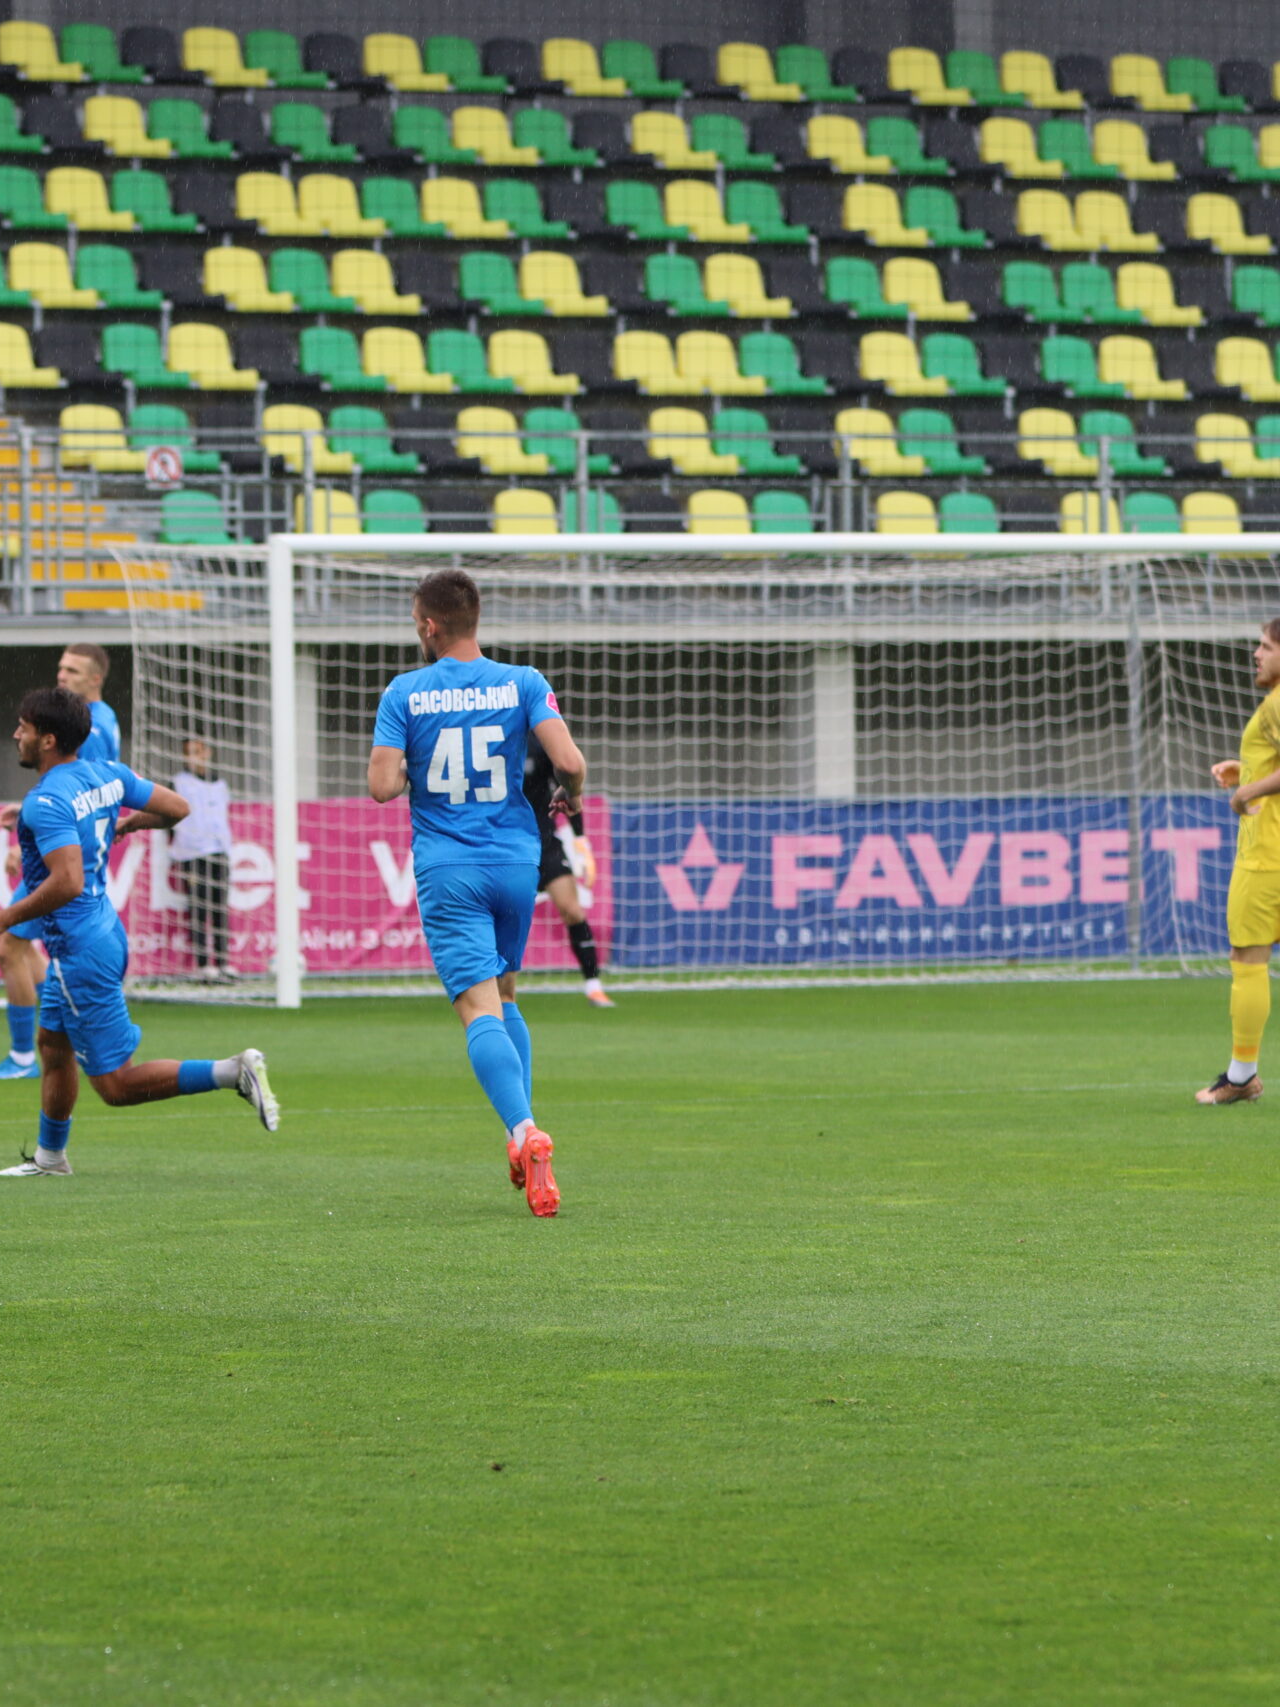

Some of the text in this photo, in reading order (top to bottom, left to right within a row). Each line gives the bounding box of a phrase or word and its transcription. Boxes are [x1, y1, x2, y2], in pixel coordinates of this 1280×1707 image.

[408, 680, 519, 716] САСОВСЬКИЙ
[427, 725, 508, 805] 45
[771, 829, 1220, 910] FAVBET
